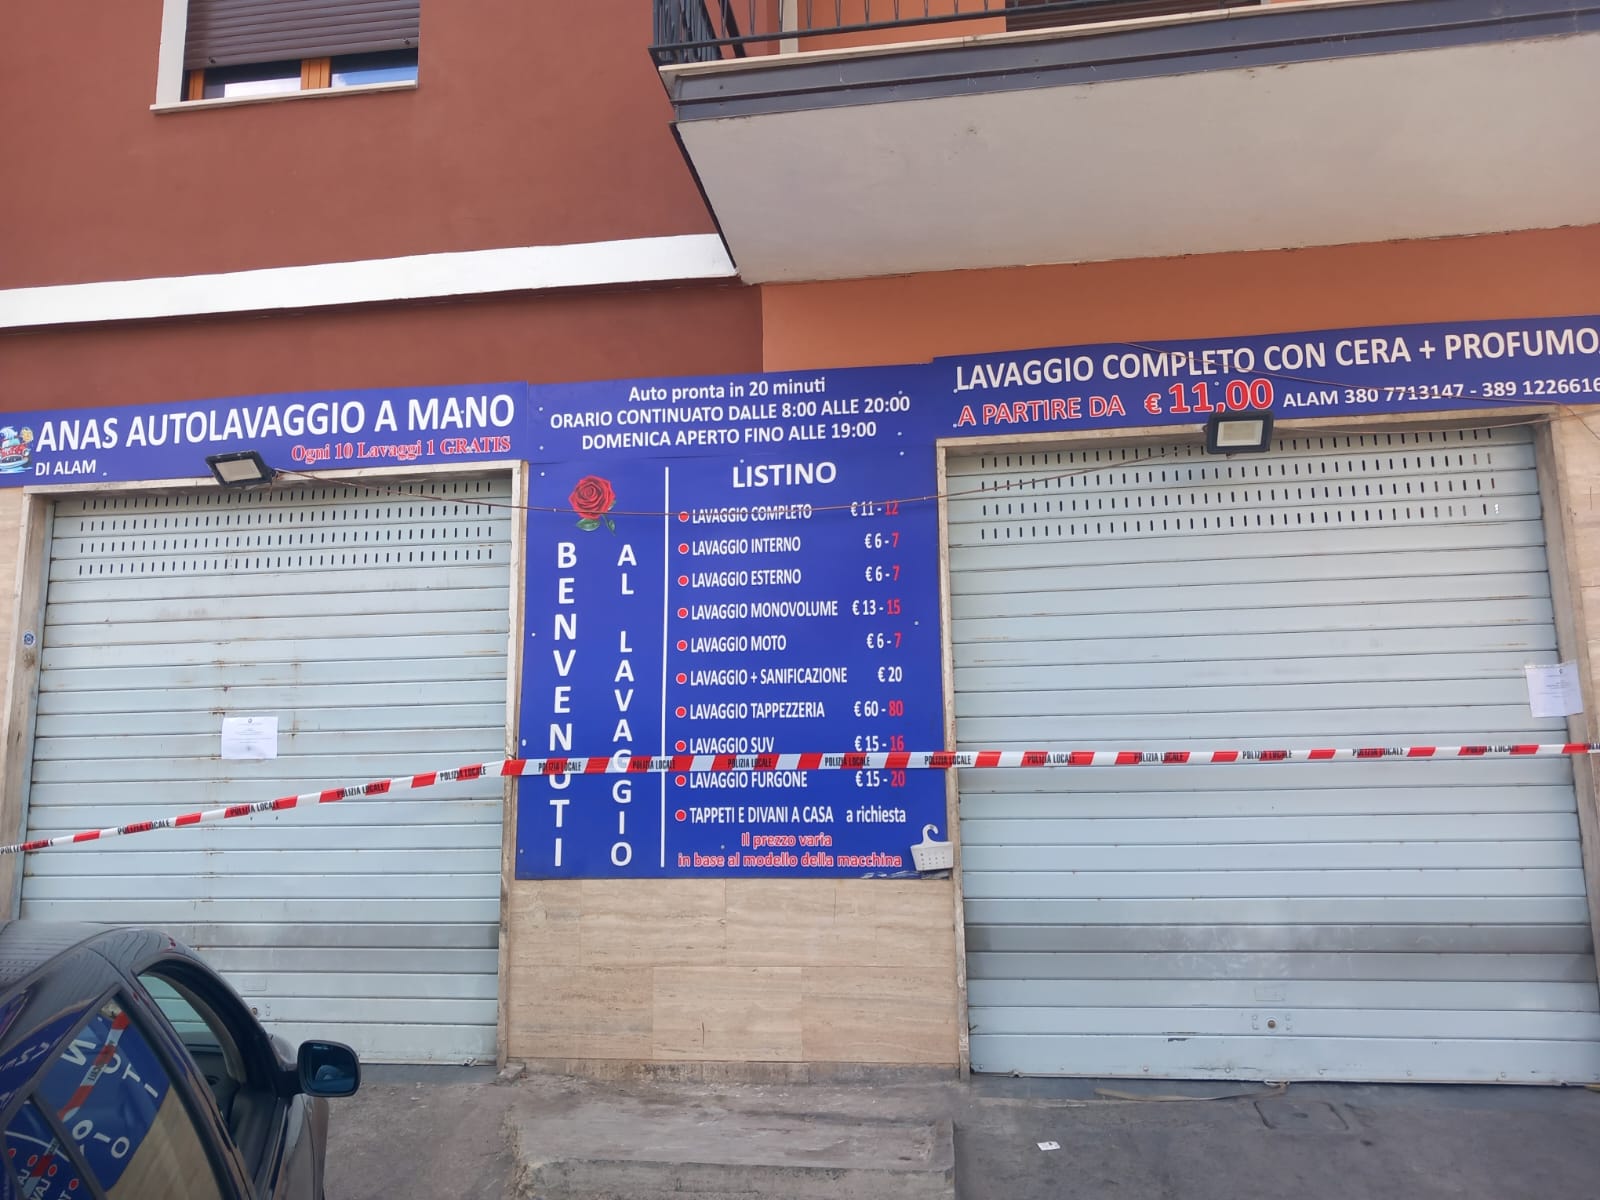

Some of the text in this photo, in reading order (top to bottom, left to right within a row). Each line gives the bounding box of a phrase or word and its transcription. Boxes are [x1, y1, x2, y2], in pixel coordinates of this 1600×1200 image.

[955, 328, 1598, 391] LAVAGGIO COMPLETO CON CERA + PROFUMO
[629, 377, 825, 404] Auto pronta in 20 minuti
[550, 396, 911, 429] ORARIO CONTINUATO DALLE 8:00 ALLE 20:00
[957, 406, 977, 426] A
[982, 397, 1082, 426] PARTIRE
[1089, 396, 1126, 418] DA
[1169, 378, 1274, 414] 11,00
[1282, 390, 1340, 408] ALAM
[1344, 388, 1378, 405] 380
[1383, 384, 1464, 401] 7713147
[1482, 381, 1516, 396] 389
[1522, 378, 1600, 395] 1226616
[36, 394, 515, 452] ANAS AUTOLAVAGGIO A MANO
[582, 421, 876, 451] DOMENICA APERTO FINO ALLE 19:00
[292, 435, 511, 465] Ogni 10 Lavaggi 1 GRATIS
[36, 459, 97, 476] DI ALAM
[732, 461, 837, 488] LISTINO
[692, 506, 748, 525] LAVAGGIO
[751, 503, 812, 521] COMPLETO
[861, 501, 874, 516] 11
[885, 500, 899, 515] 12
[692, 538, 748, 556] LAVAGGIO
[751, 536, 801, 553] INTERNO
[864, 533, 872, 548] €
[875, 533, 882, 548] 6
[892, 532, 899, 548] 7
[692, 571, 748, 589] LAVAGGIO
[751, 568, 801, 585] ESTERNO
[865, 566, 872, 581] €
[875, 566, 882, 581] 6
[892, 565, 900, 581] 7
[691, 602, 748, 620] LAVAGGIO
[751, 599, 838, 618] MONOVOLUME
[852, 600, 859, 616] €
[863, 599, 876, 615] 13
[887, 599, 901, 615] 15
[691, 634, 748, 653] LAVAGGIO
[751, 633, 786, 651] MOTO
[867, 633, 874, 649] €
[876, 633, 884, 649] 6
[894, 632, 901, 648] 7
[690, 664, 902, 686] LAVAGGIO + SANIFICAZIONE € 20
[549, 541, 577, 867] BENVENUTI
[610, 544, 637, 867] AL LAVAGGIO
[690, 700, 747, 720] LAVAGGIO
[750, 698, 825, 719] TAPPEZZERIA
[854, 701, 861, 717] €
[863, 700, 878, 717] 60
[888, 699, 903, 716] 80
[690, 735, 748, 754] LAVAGGIO
[750, 735, 774, 752] SUV
[855, 735, 862, 752] €
[864, 735, 879, 752] 15
[890, 735, 904, 752] 16
[538, 761, 581, 772] POLIZIA LOCALE
[728, 758, 771, 768] POLIZIA LOCALE
[825, 756, 870, 767] POLIZIA LOCALE
[924, 754, 971, 766] POLIZIA LOCALE
[690, 771, 748, 789] LAVAGGIO
[751, 770, 807, 788] FURGONE
[855, 771, 863, 788] €
[865, 770, 881, 787] 15
[891, 770, 906, 787] 20
[690, 806, 906, 825] TAPPETI E DIVANI A CASA a richiesta
[741, 833, 832, 849] Il prezzo varia
[678, 853, 902, 868] in base al modello della macchina
